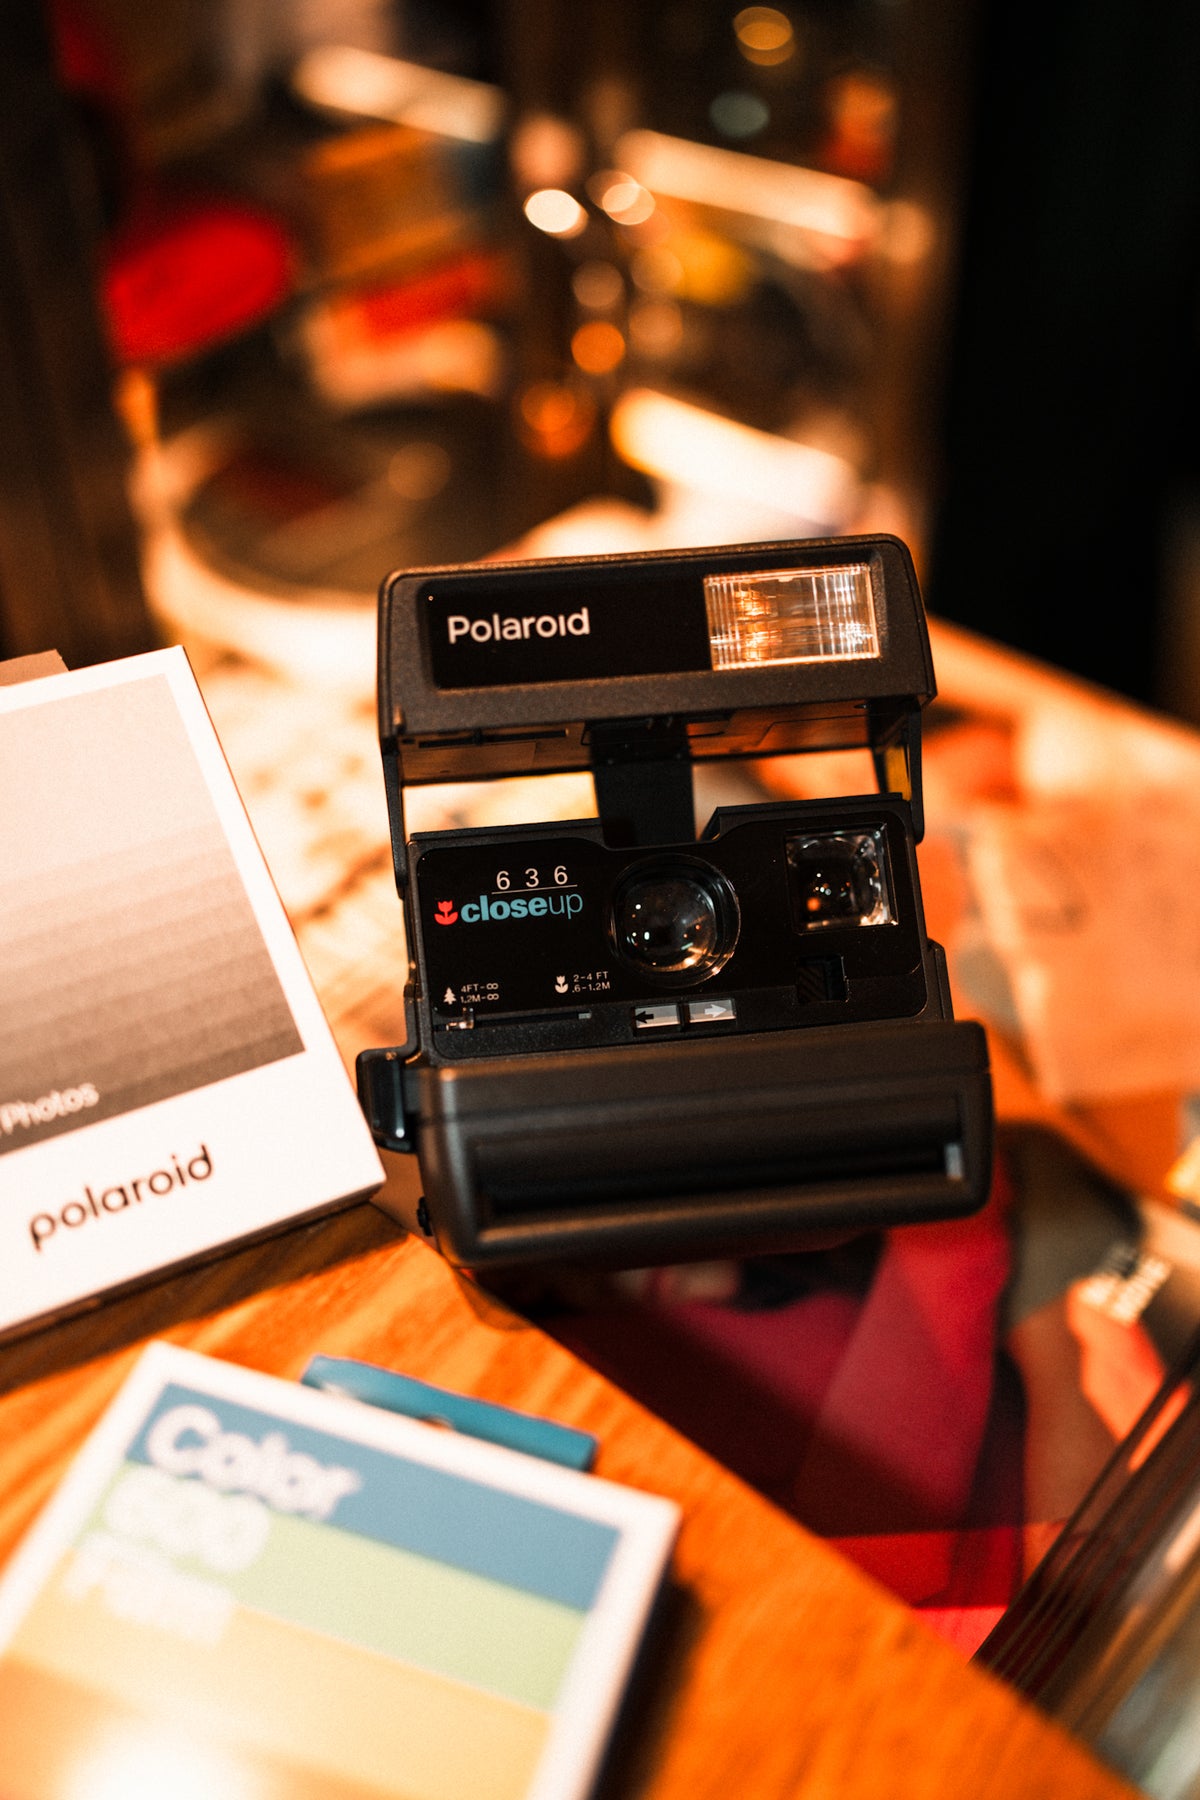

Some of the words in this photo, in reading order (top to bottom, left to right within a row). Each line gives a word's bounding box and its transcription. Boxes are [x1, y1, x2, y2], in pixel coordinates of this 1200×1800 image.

[447, 606, 591, 645] Polaroid
[460, 893, 584, 923] closeup
[596, 971, 609, 980] FT
[30, 1142, 213, 1252] polaroid
